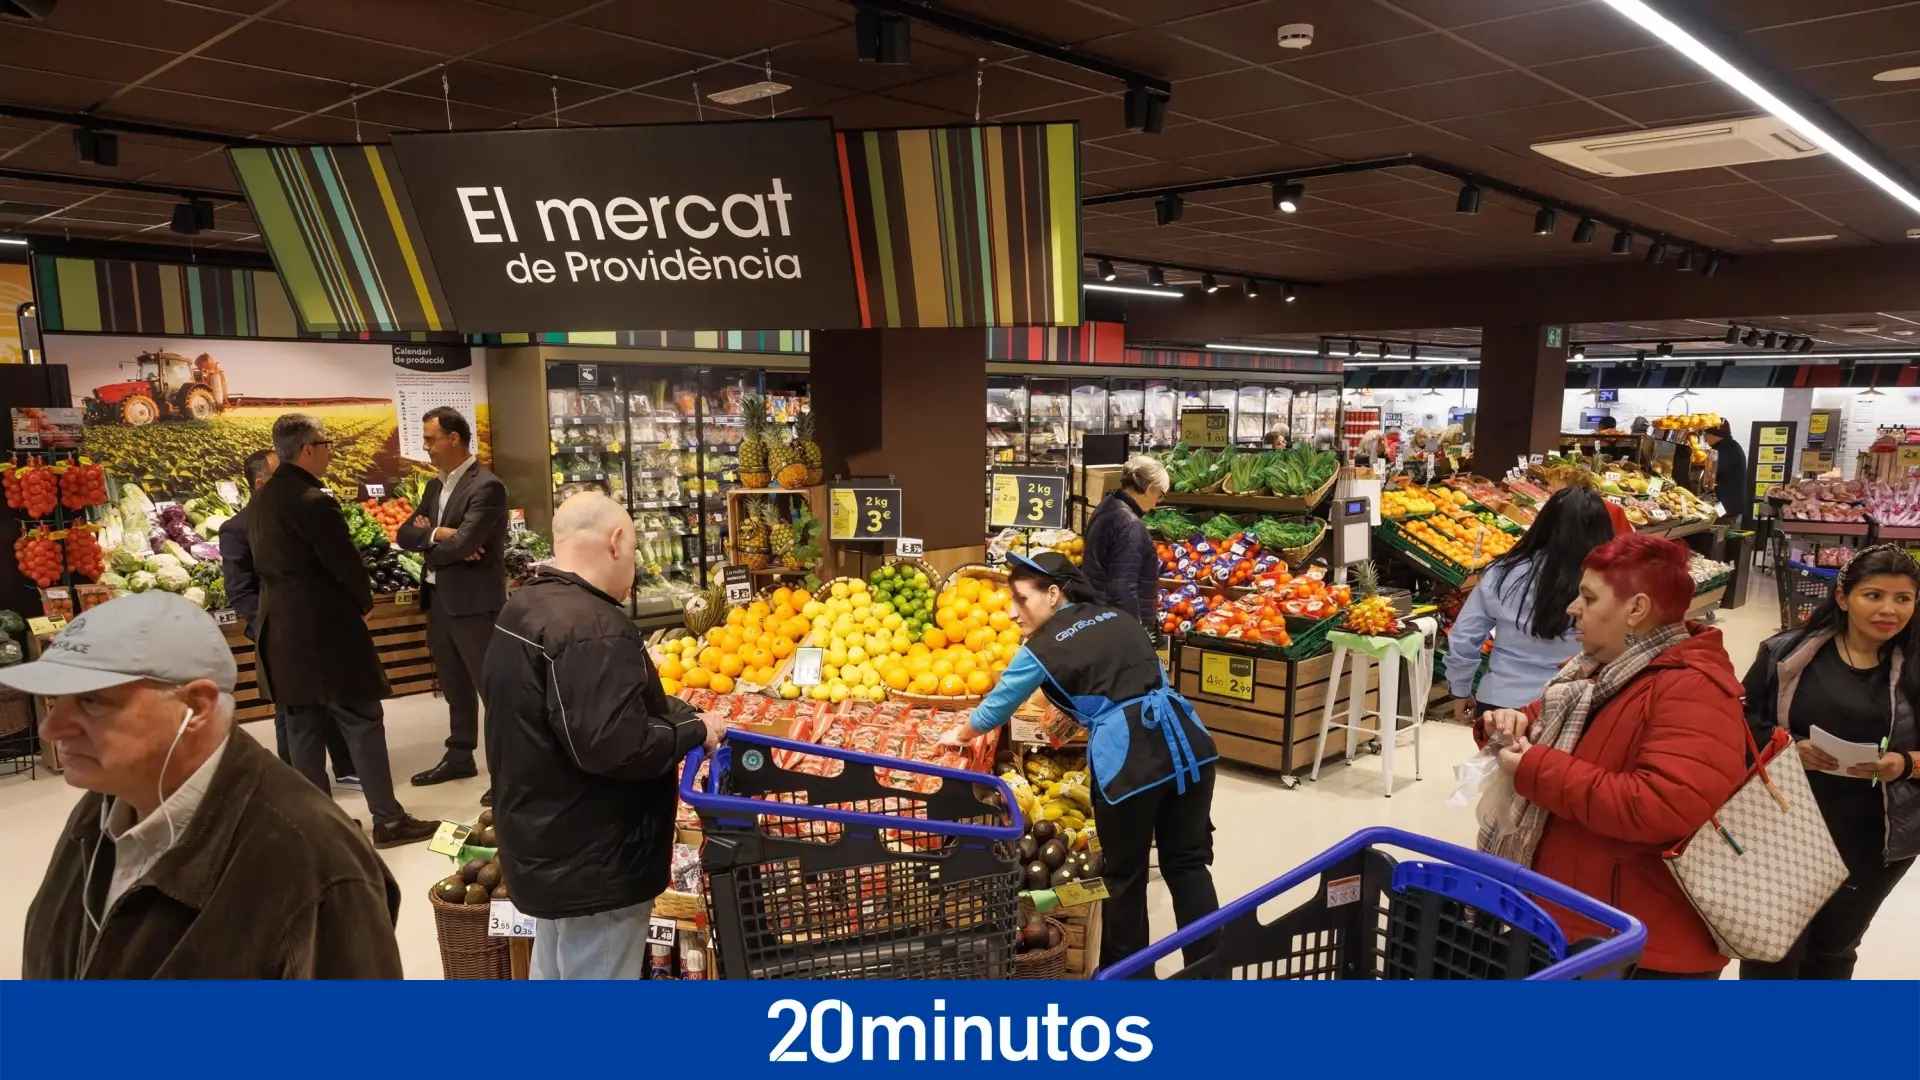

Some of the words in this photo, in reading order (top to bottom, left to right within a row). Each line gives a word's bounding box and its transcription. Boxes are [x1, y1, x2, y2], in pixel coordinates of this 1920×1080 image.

[456, 186, 519, 244] El
[536, 178, 793, 242] mercat
[506, 252, 556, 284] de
[565, 246, 802, 283] Providència
[394, 347, 432, 355] Calendari
[406, 356, 445, 364] producció
[1600, 391, 1614, 401] 34
[1207, 418, 1223, 427] 2x1
[1028, 483, 1035, 493] 2
[1037, 483, 1051, 496] kg
[866, 497, 873, 506] 2
[875, 497, 888, 508] kg
[1055, 620, 1096, 642] caprabo
[1230, 679, 1251, 694] 2,99
[491, 918, 510, 930] 3,55
[513, 924, 533, 935] 0,35
